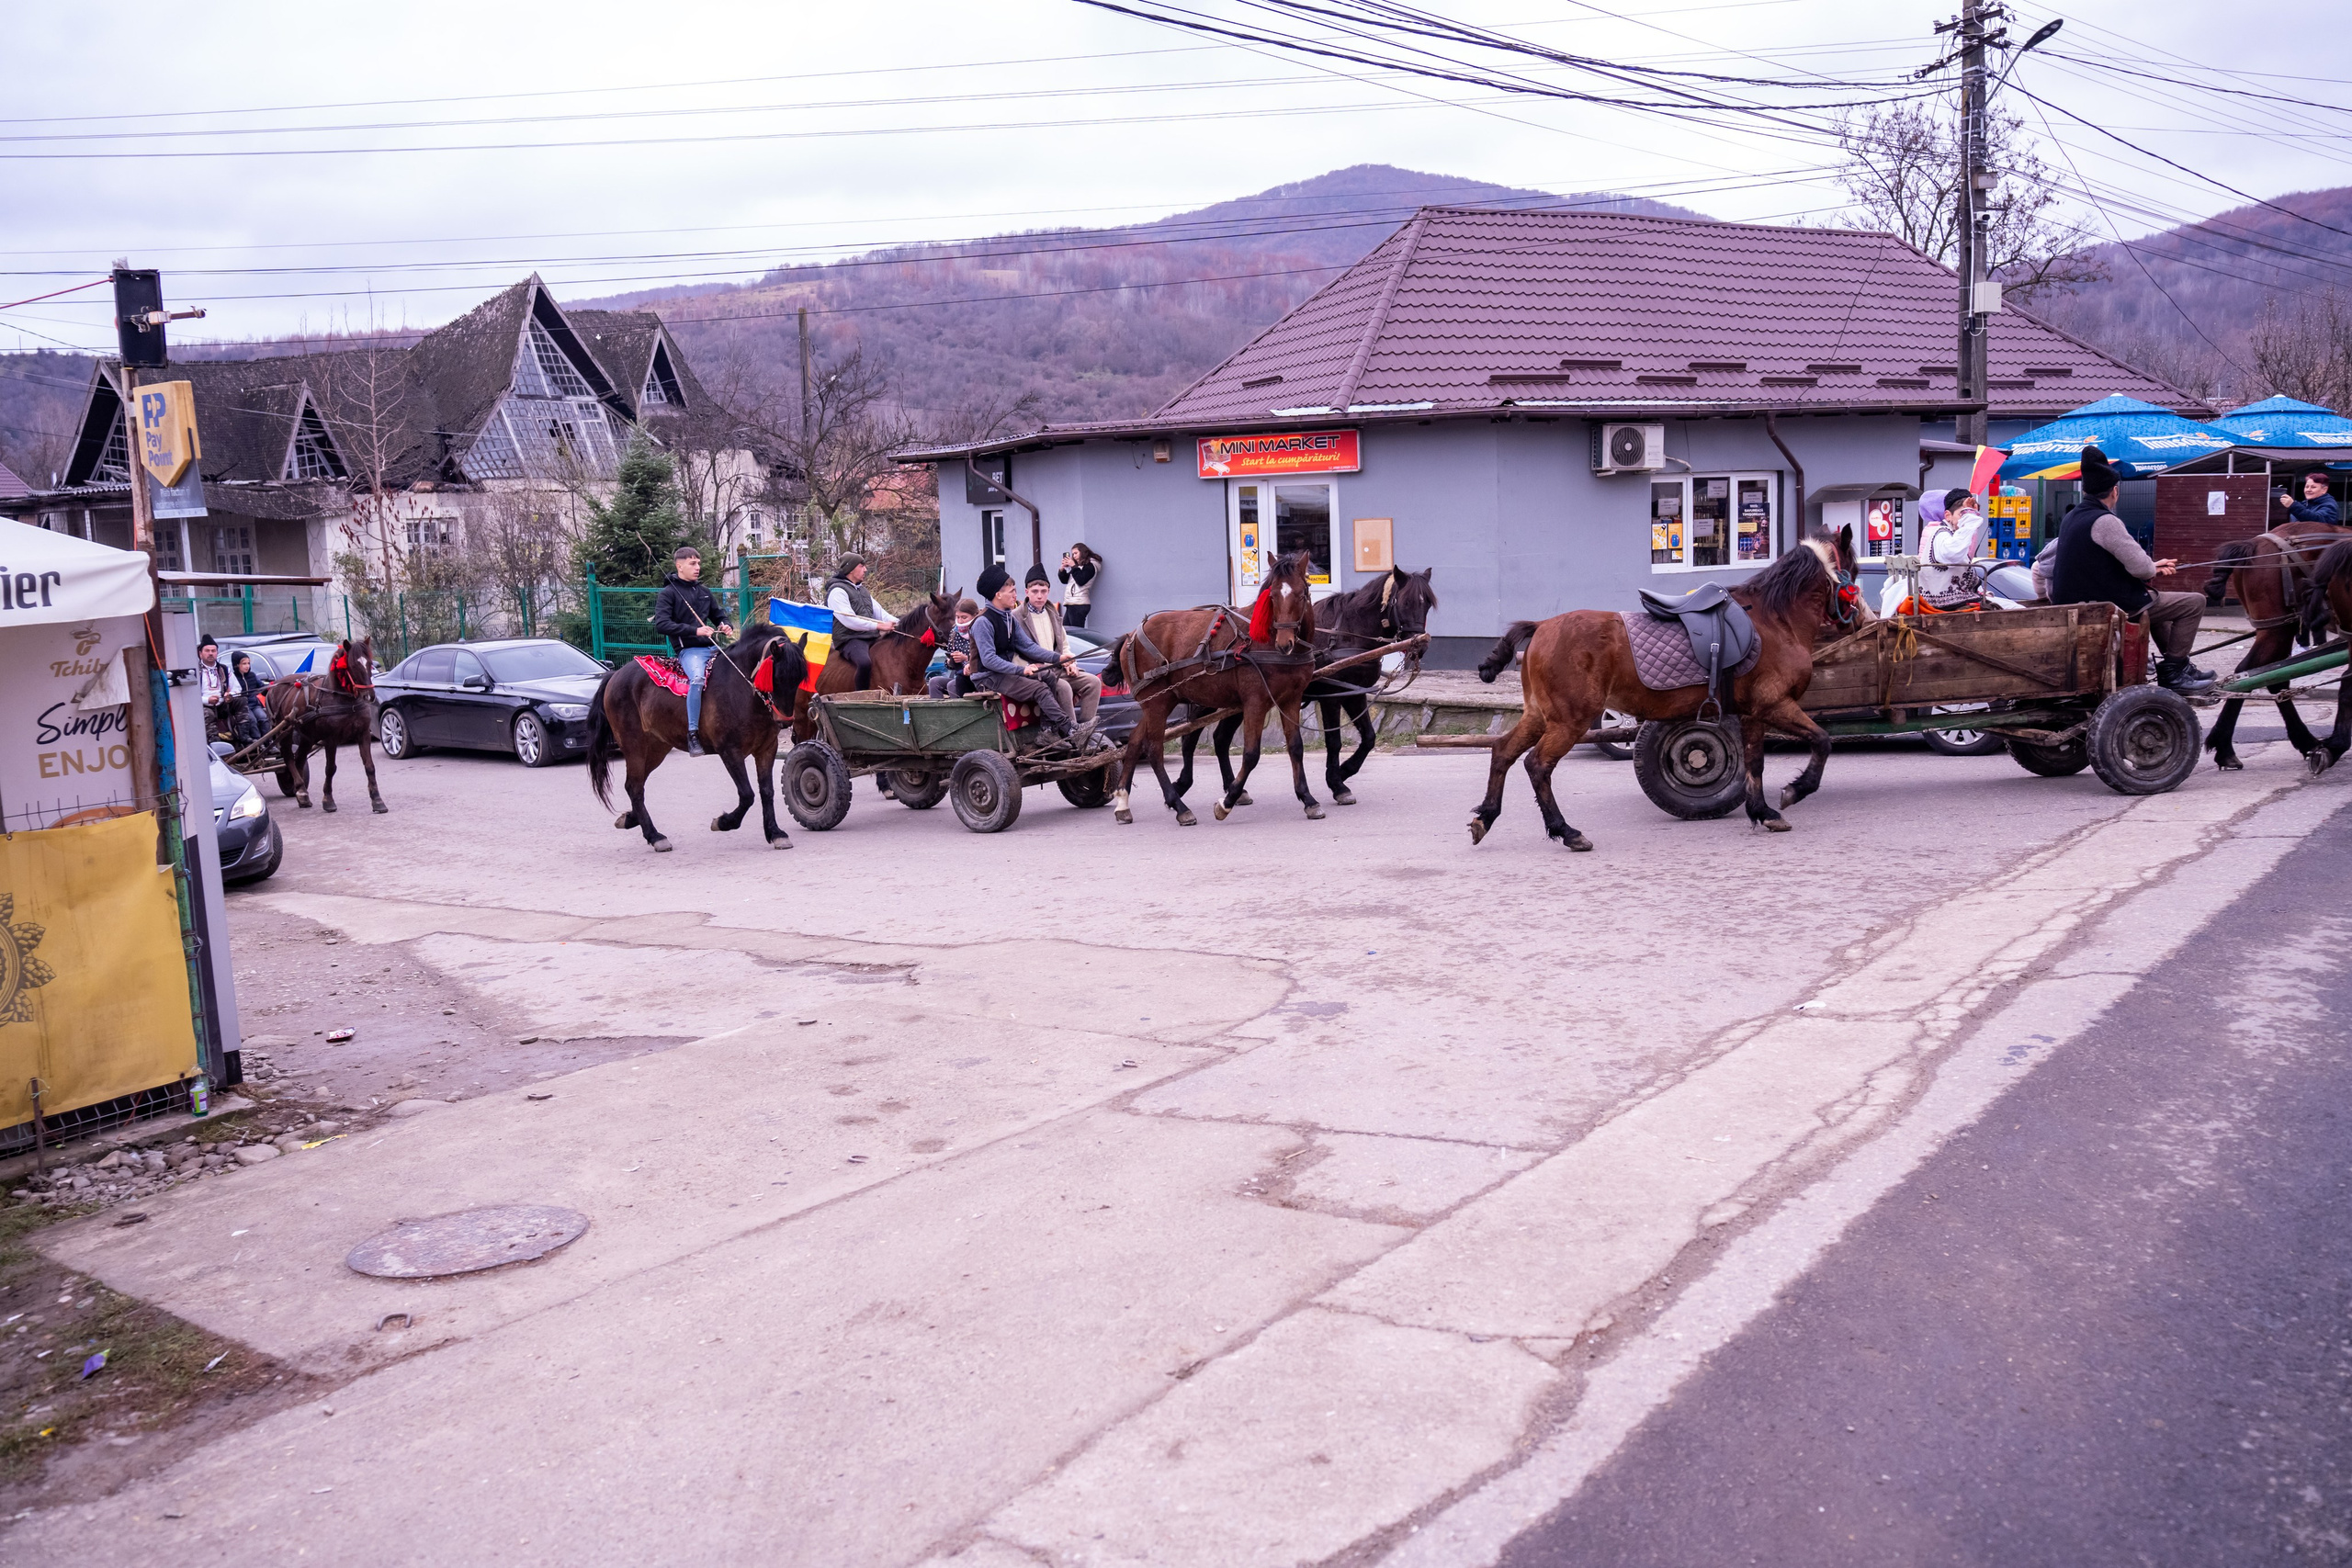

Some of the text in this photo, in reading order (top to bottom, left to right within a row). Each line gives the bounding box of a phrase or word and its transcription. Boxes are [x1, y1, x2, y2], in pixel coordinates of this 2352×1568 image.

[145, 431, 162, 452] Pay
[1220, 434, 1340, 455] MINI MARKET
[148, 450, 174, 467] Point
[1240, 451, 1340, 467] Start la cumpărături!
[0, 566, 61, 610] ier
[50, 658, 110, 678] Tchib
[36, 702, 128, 745] Simpl
[38, 744, 130, 779] ENJO
